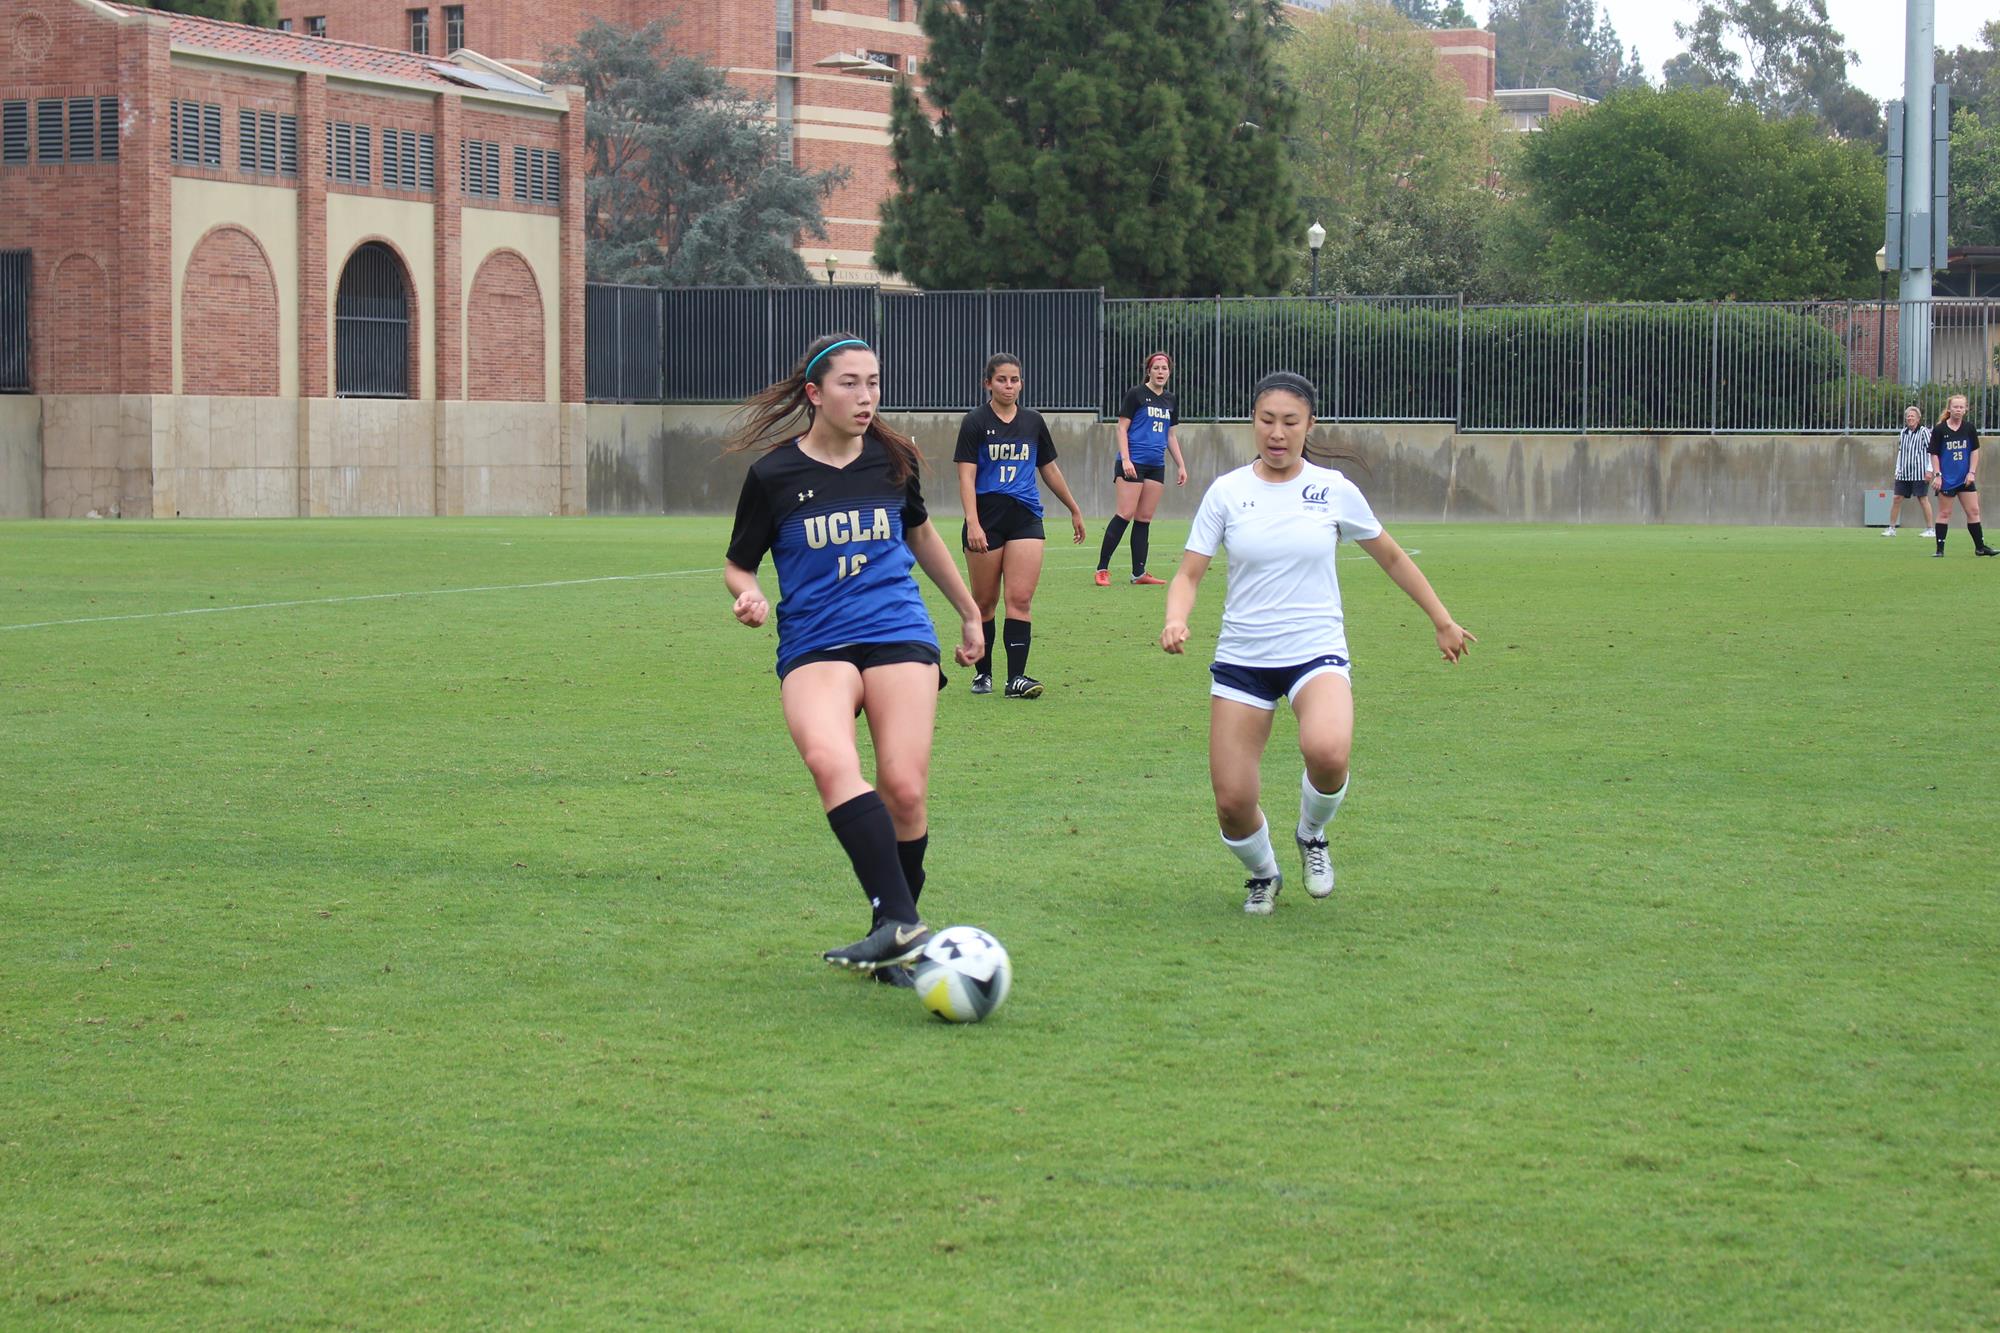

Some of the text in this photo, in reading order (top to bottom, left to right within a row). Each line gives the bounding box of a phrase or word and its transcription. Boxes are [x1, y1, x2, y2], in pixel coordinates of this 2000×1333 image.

[820, 271, 861, 281] CLLINS
[1147, 406, 1171, 420] UCLA
[1152, 421, 1164, 433] 20
[988, 443, 1029, 461] UCLA
[1946, 440, 1967, 450] UCLA
[1953, 451, 1963, 460] 25
[1000, 466, 1017, 483] 17
[1302, 483, 1329, 501] Cal
[804, 508, 891, 550] UCLA
